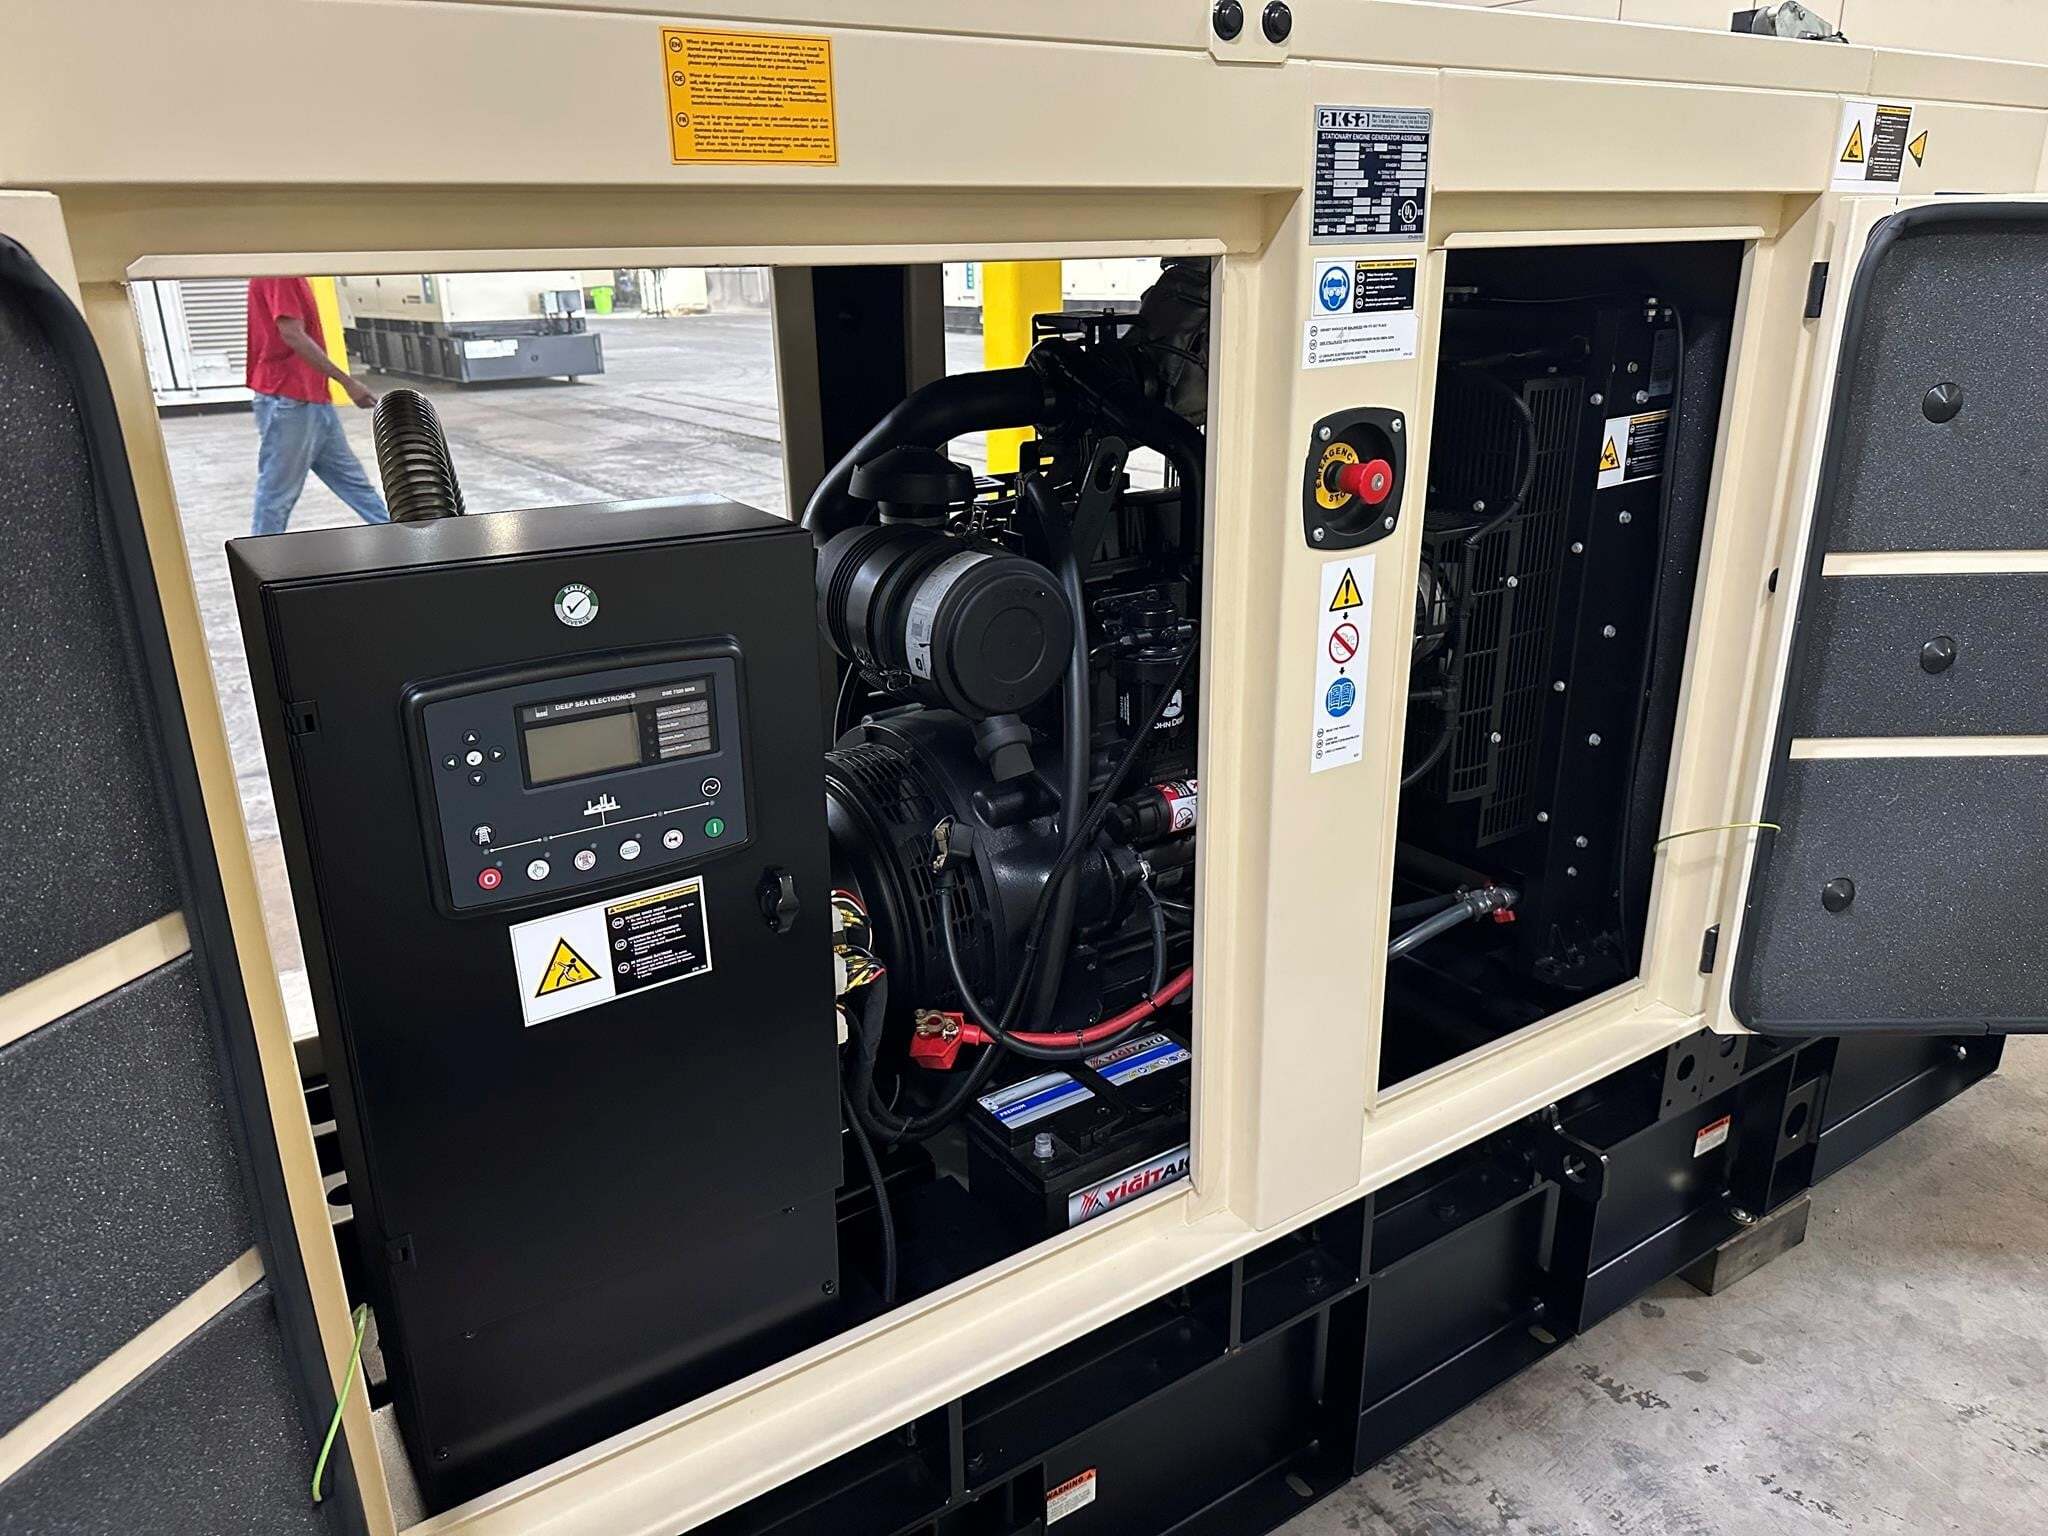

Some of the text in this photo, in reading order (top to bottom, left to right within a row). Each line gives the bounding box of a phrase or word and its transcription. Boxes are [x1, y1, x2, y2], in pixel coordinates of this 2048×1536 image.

[1320, 112, 1370, 127] aksa
[1328, 490, 1346, 502] STO
[555, 702, 573, 710] DEEP
[590, 692, 636, 705] ELECTRONICS
[1046, 1476, 1083, 1499] WARNING
